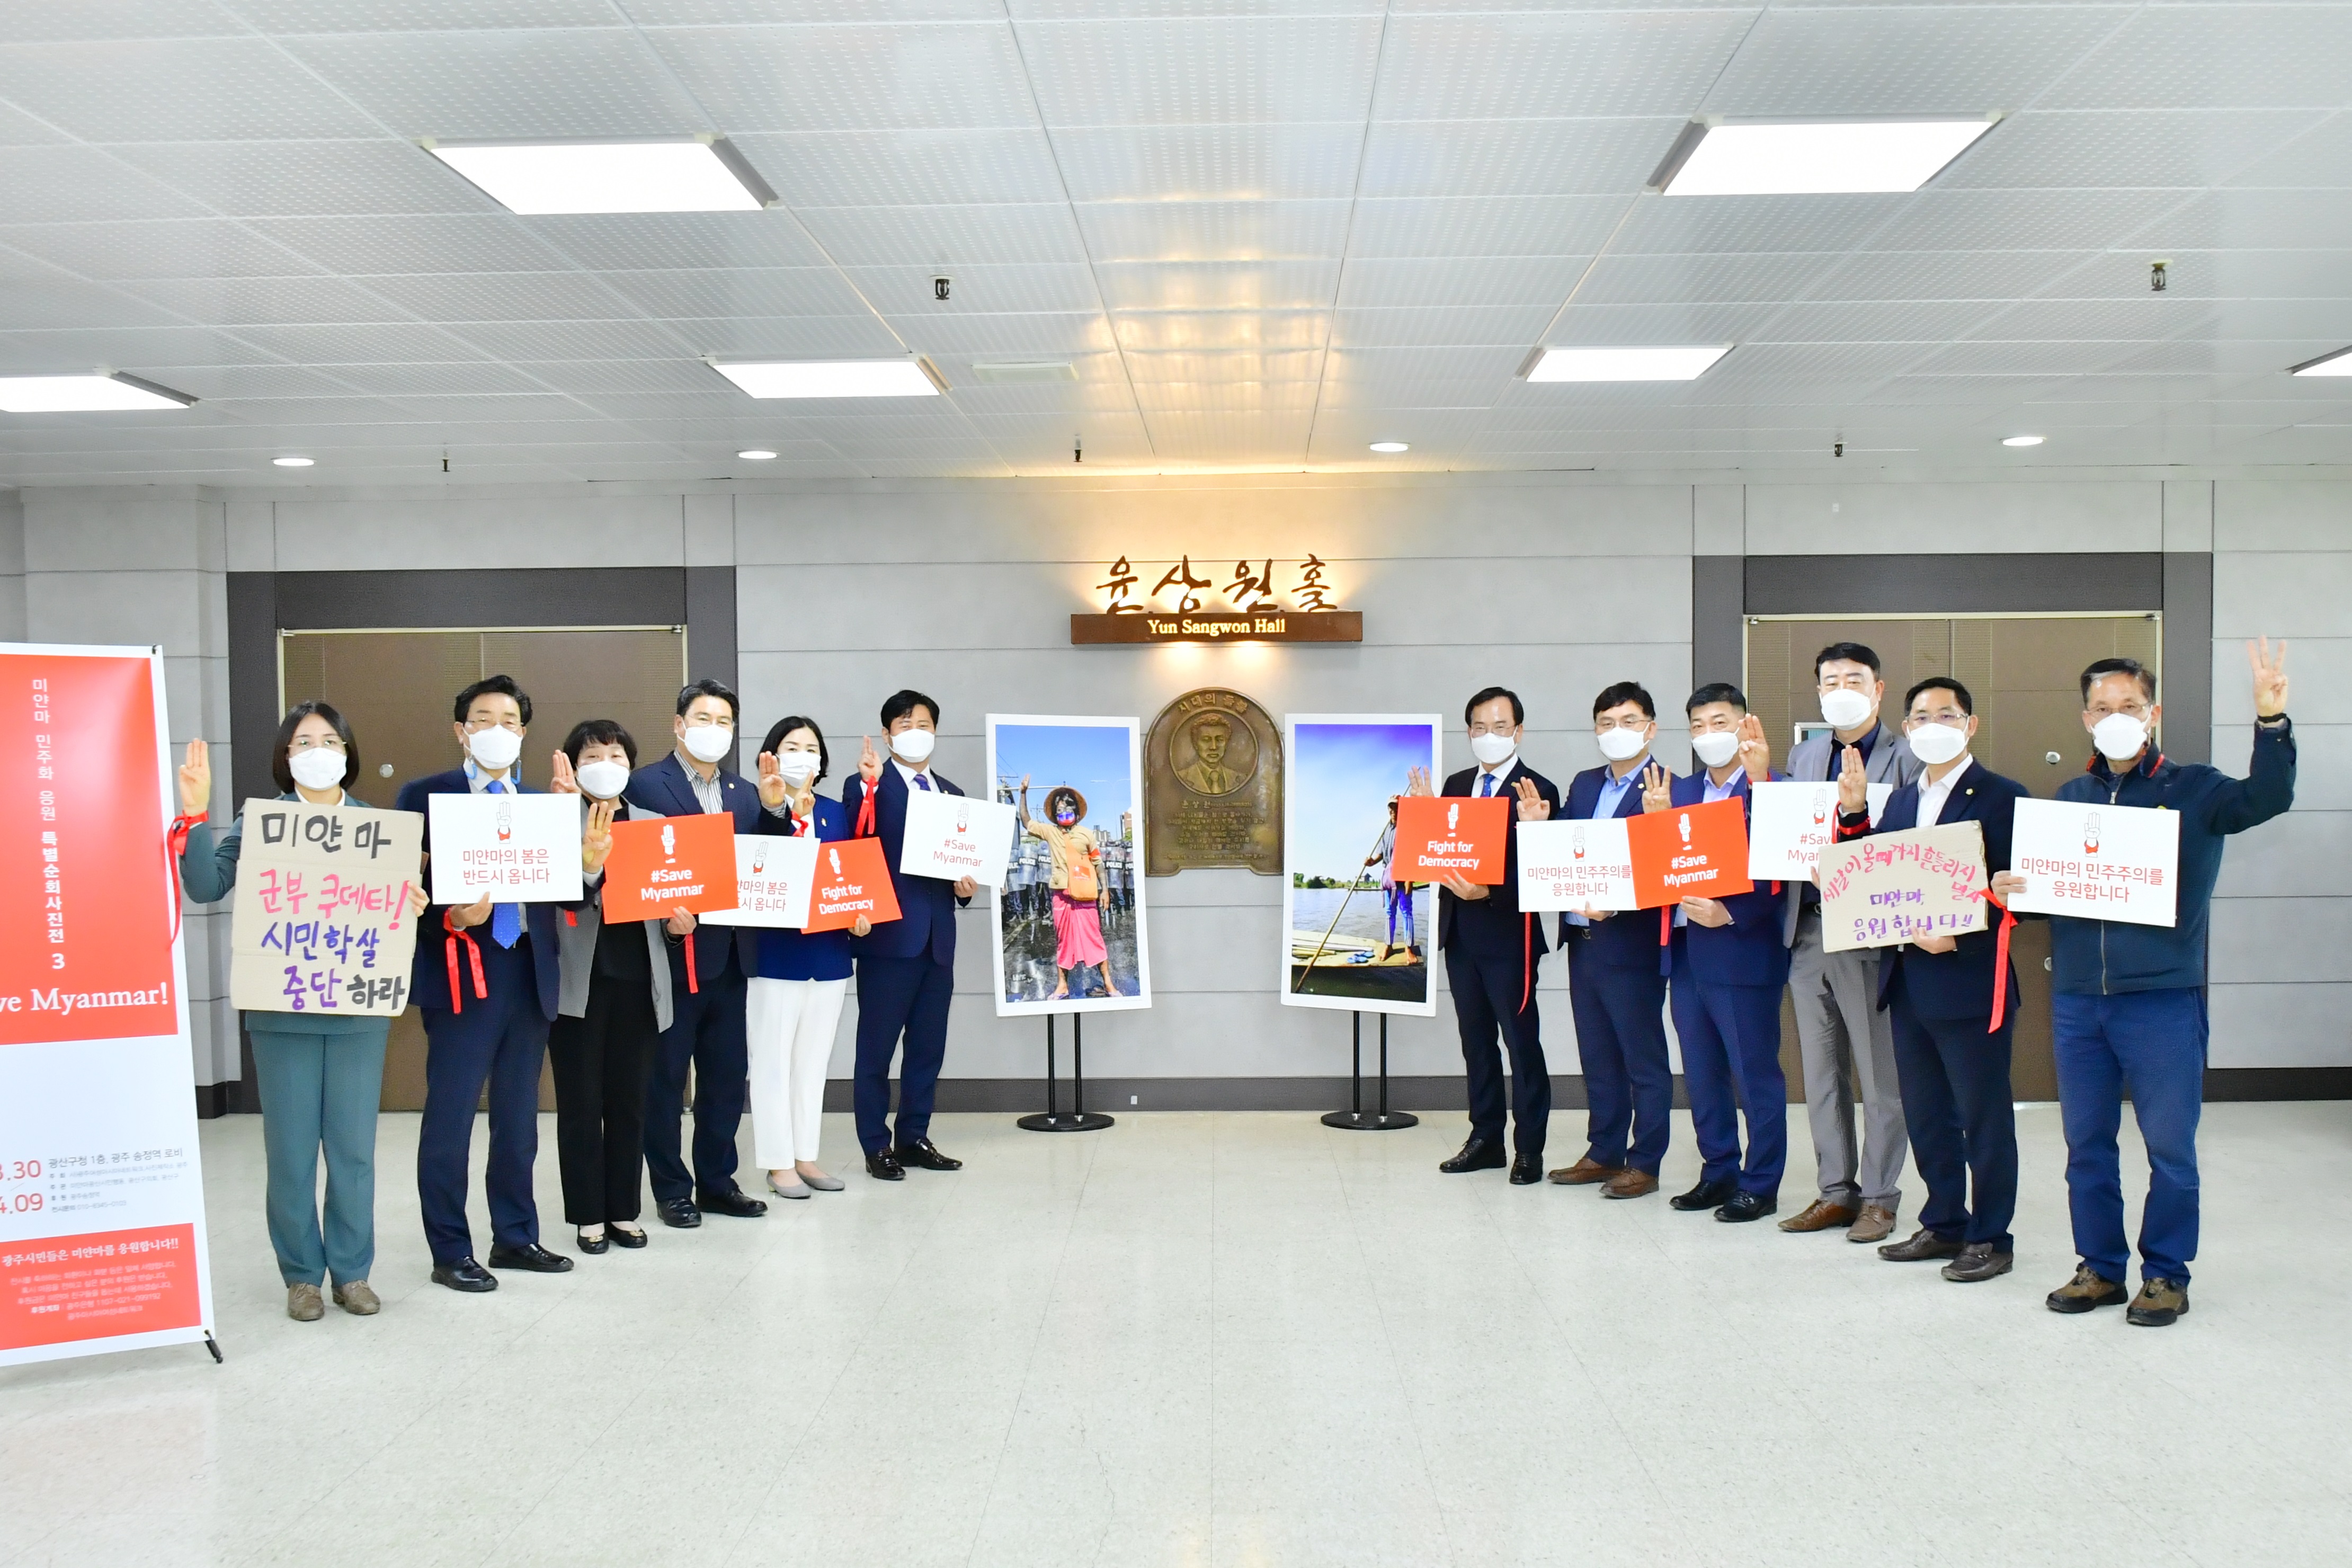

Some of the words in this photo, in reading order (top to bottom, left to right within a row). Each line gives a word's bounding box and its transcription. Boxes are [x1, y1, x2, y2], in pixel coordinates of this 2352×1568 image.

[1147, 619, 1178, 634] Yun
[1181, 619, 1251, 637] Sangwon
[1254, 619, 1286, 633] Hall
[32, 679, 50, 724] 미얀마
[36, 734, 54, 780] 민주화
[39, 790, 56, 821] 응원
[944, 839, 976, 852] #Save
[1799, 833, 1831, 844] #Sav
[1427, 840, 1456, 855] Fight
[1457, 841, 1474, 853] for
[463, 849, 516, 865] 미얀마의
[521, 849, 549, 864] 봄은
[933, 851, 983, 867] Myanmar
[1418, 855, 1480, 870] Democracy
[1671, 855, 1707, 869] #Save
[463, 869, 503, 885] 반드시
[507, 868, 550, 884] 옵니다
[651, 869, 692, 883] #Save
[1528, 867, 1572, 880] 미얀마의
[1576, 865, 1632, 879] 민주주의를
[1663, 869, 1718, 888] Myanmar
[2021, 858, 2080, 878] 미얀마의
[2086, 863, 2164, 886] 민주주의를
[640, 884, 705, 902] Myanmar
[767, 881, 788, 895] 봄은
[821, 885, 849, 901] Fight
[848, 884, 862, 896] for
[1552, 882, 1608, 896] 응원합니다
[2052, 880, 2130, 903] 응원합니다
[259, 869, 308, 914] 군부
[317, 873, 410, 931] 쿠데타!
[754, 897, 786, 912] 옵니다
[818, 899, 874, 915] Democracy
[261, 921, 380, 968] 시민학살
[52, 952, 65, 969] 3
[30, 982, 168, 1015] Myanmar!
[48, 1156, 87, 1169] 광산구청
[111, 1152, 130, 1163] 광주
[133, 1150, 162, 1161] 송정역
[164, 1148, 183, 1158] 로비
[2, 1249, 68, 1267] 광주시민들은
[72, 1244, 115, 1258] 미얀마를
[118, 1238, 179, 1254] 응원합니다!!
